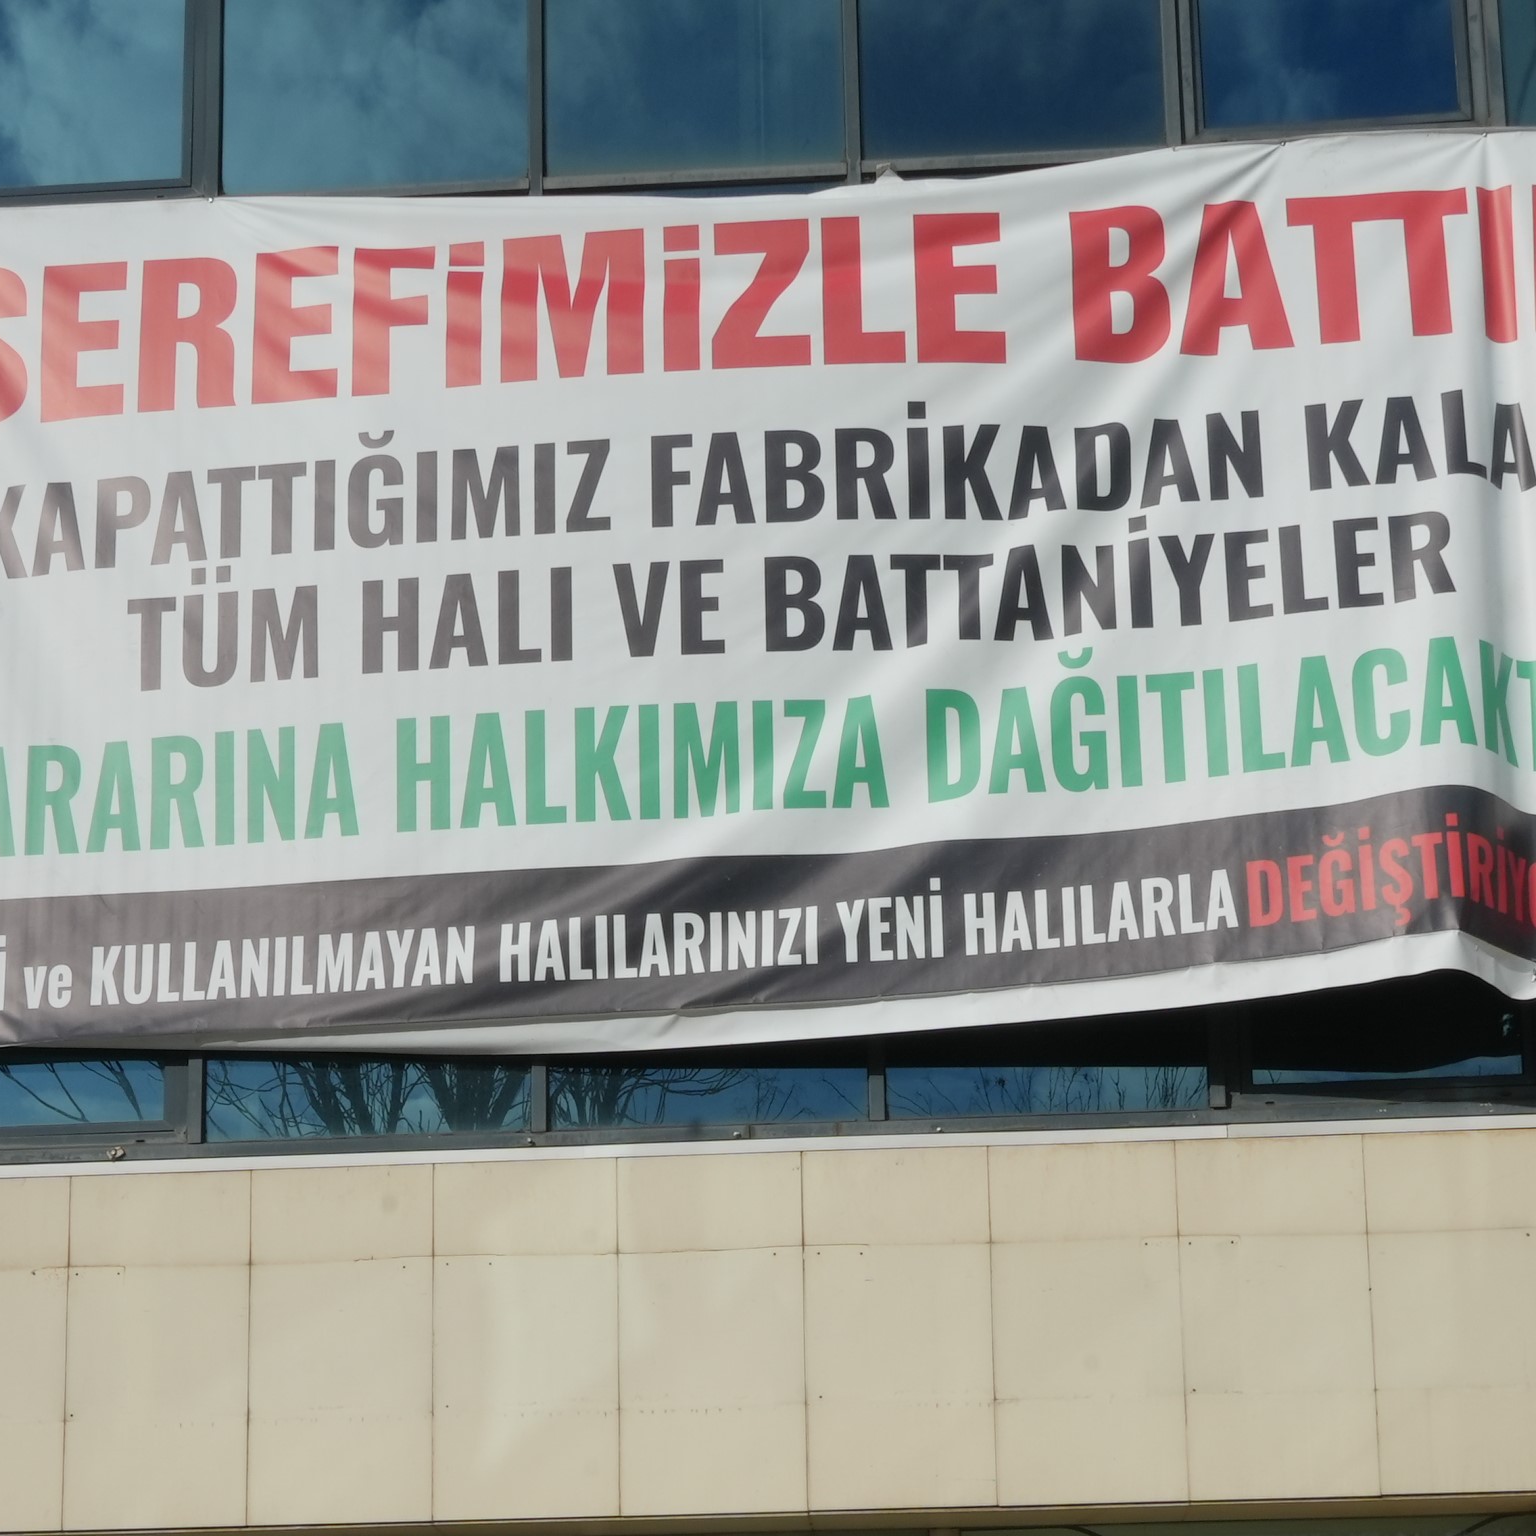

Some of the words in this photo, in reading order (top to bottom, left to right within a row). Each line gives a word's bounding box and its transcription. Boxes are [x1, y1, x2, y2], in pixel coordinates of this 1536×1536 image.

[651, 401, 1265, 528] FABRİKADAN
[127, 566, 320, 692] TÜM
[361, 567, 573, 674] HALI
[612, 558, 726, 658] VE
[764, 511, 1457, 653] BATTANİYELER
[395, 693, 891, 834] HALKIMIZA
[22, 961, 73, 1010] ve
[90, 924, 477, 1008] KULLANILMAYAN
[499, 904, 819, 983] HALILARINIZI
[836, 877, 945, 964] YENİ
[964, 869, 1239, 957] HALILARLA
